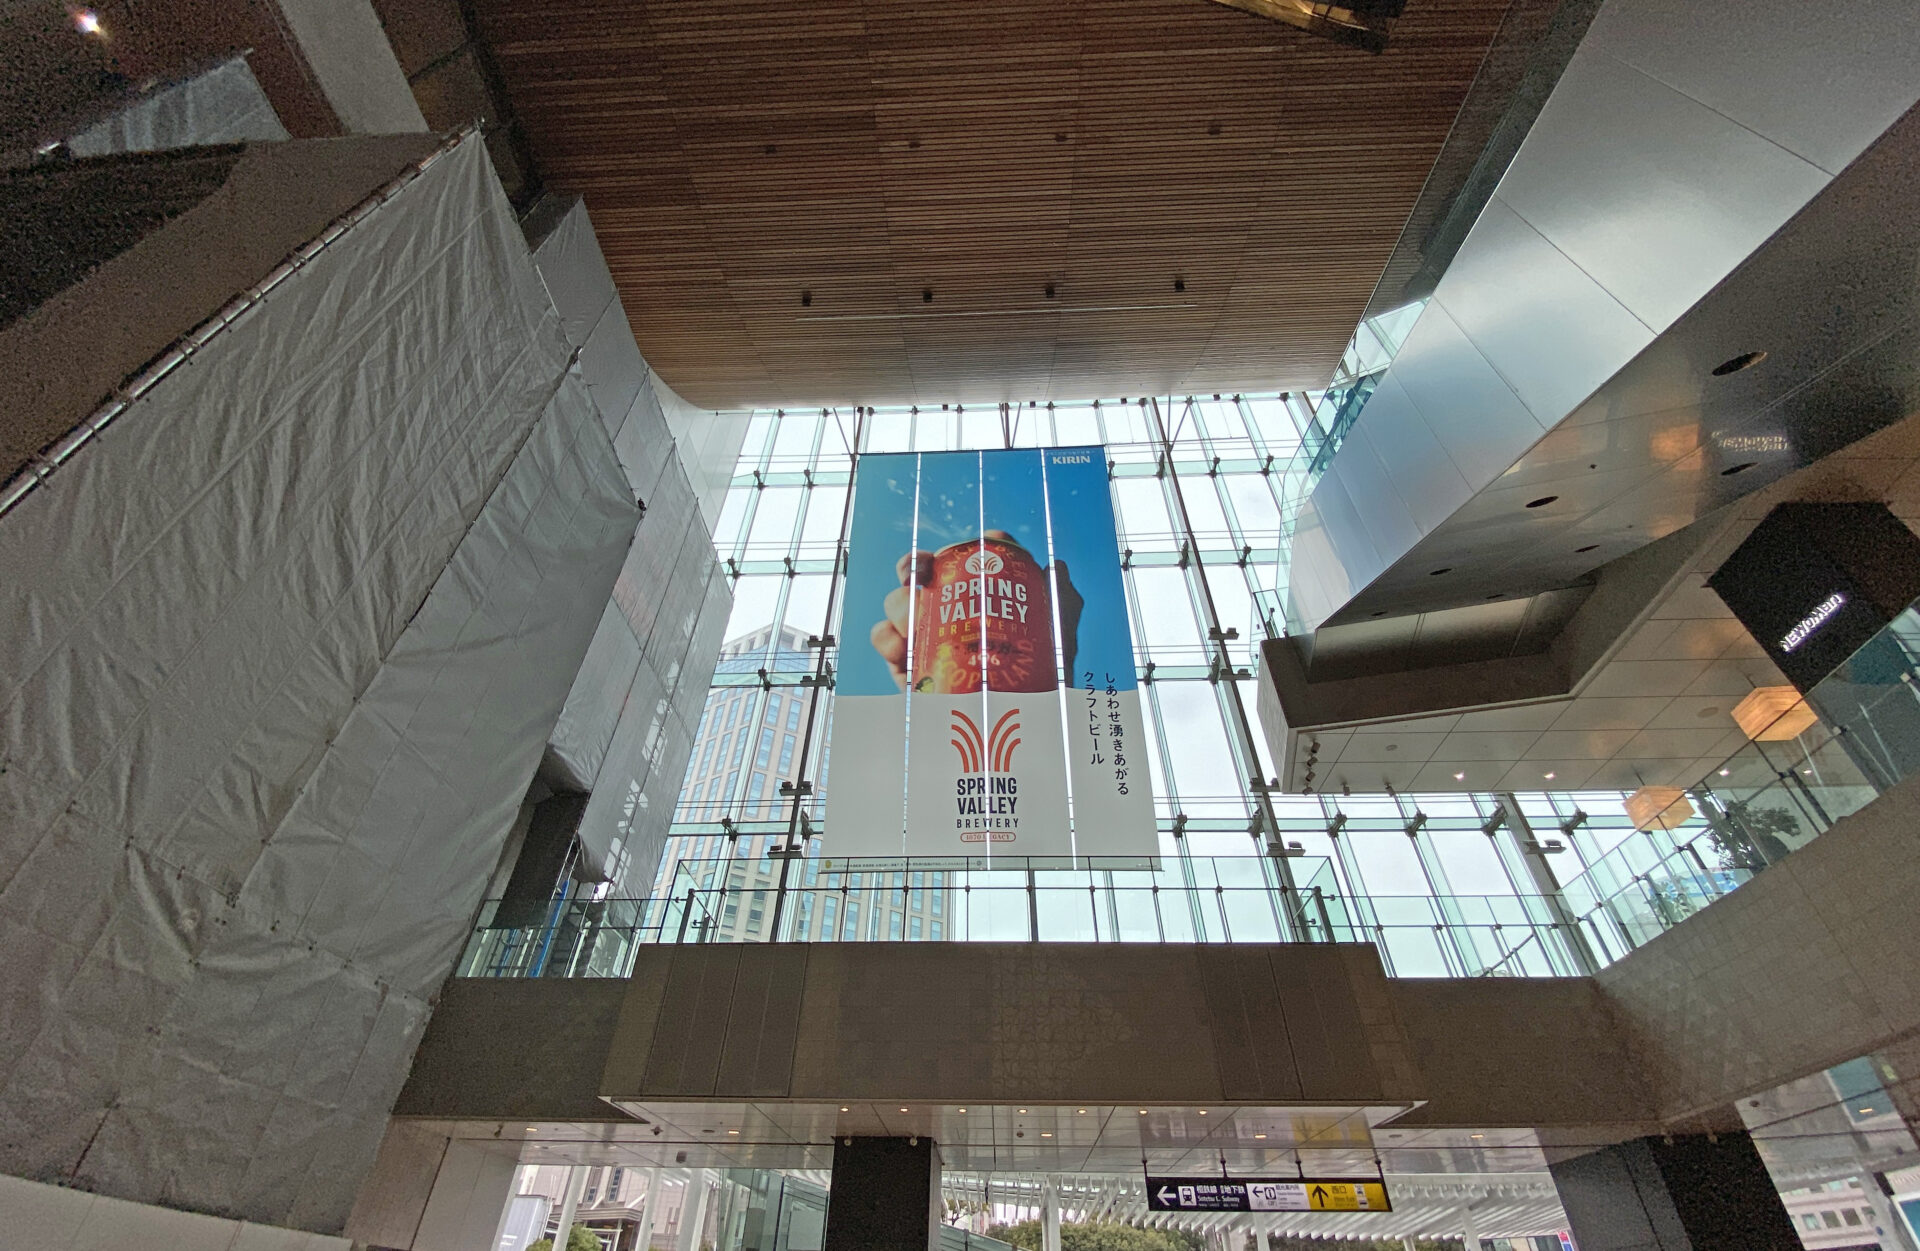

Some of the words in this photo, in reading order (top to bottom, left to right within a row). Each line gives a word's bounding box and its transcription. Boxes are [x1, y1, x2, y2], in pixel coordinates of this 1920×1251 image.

[1053, 456, 1091, 464] KIRIN
[941, 577, 1027, 602] SPRING
[940, 597, 1028, 624] VALLEY
[1084, 671, 1104, 765] クラフトビール
[1105, 672, 1129, 795] しあわせ湧きあがる
[957, 777, 1017, 795] SPRING
[957, 797, 1017, 815] VALLEY
[957, 818, 1018, 828] BREWERY
